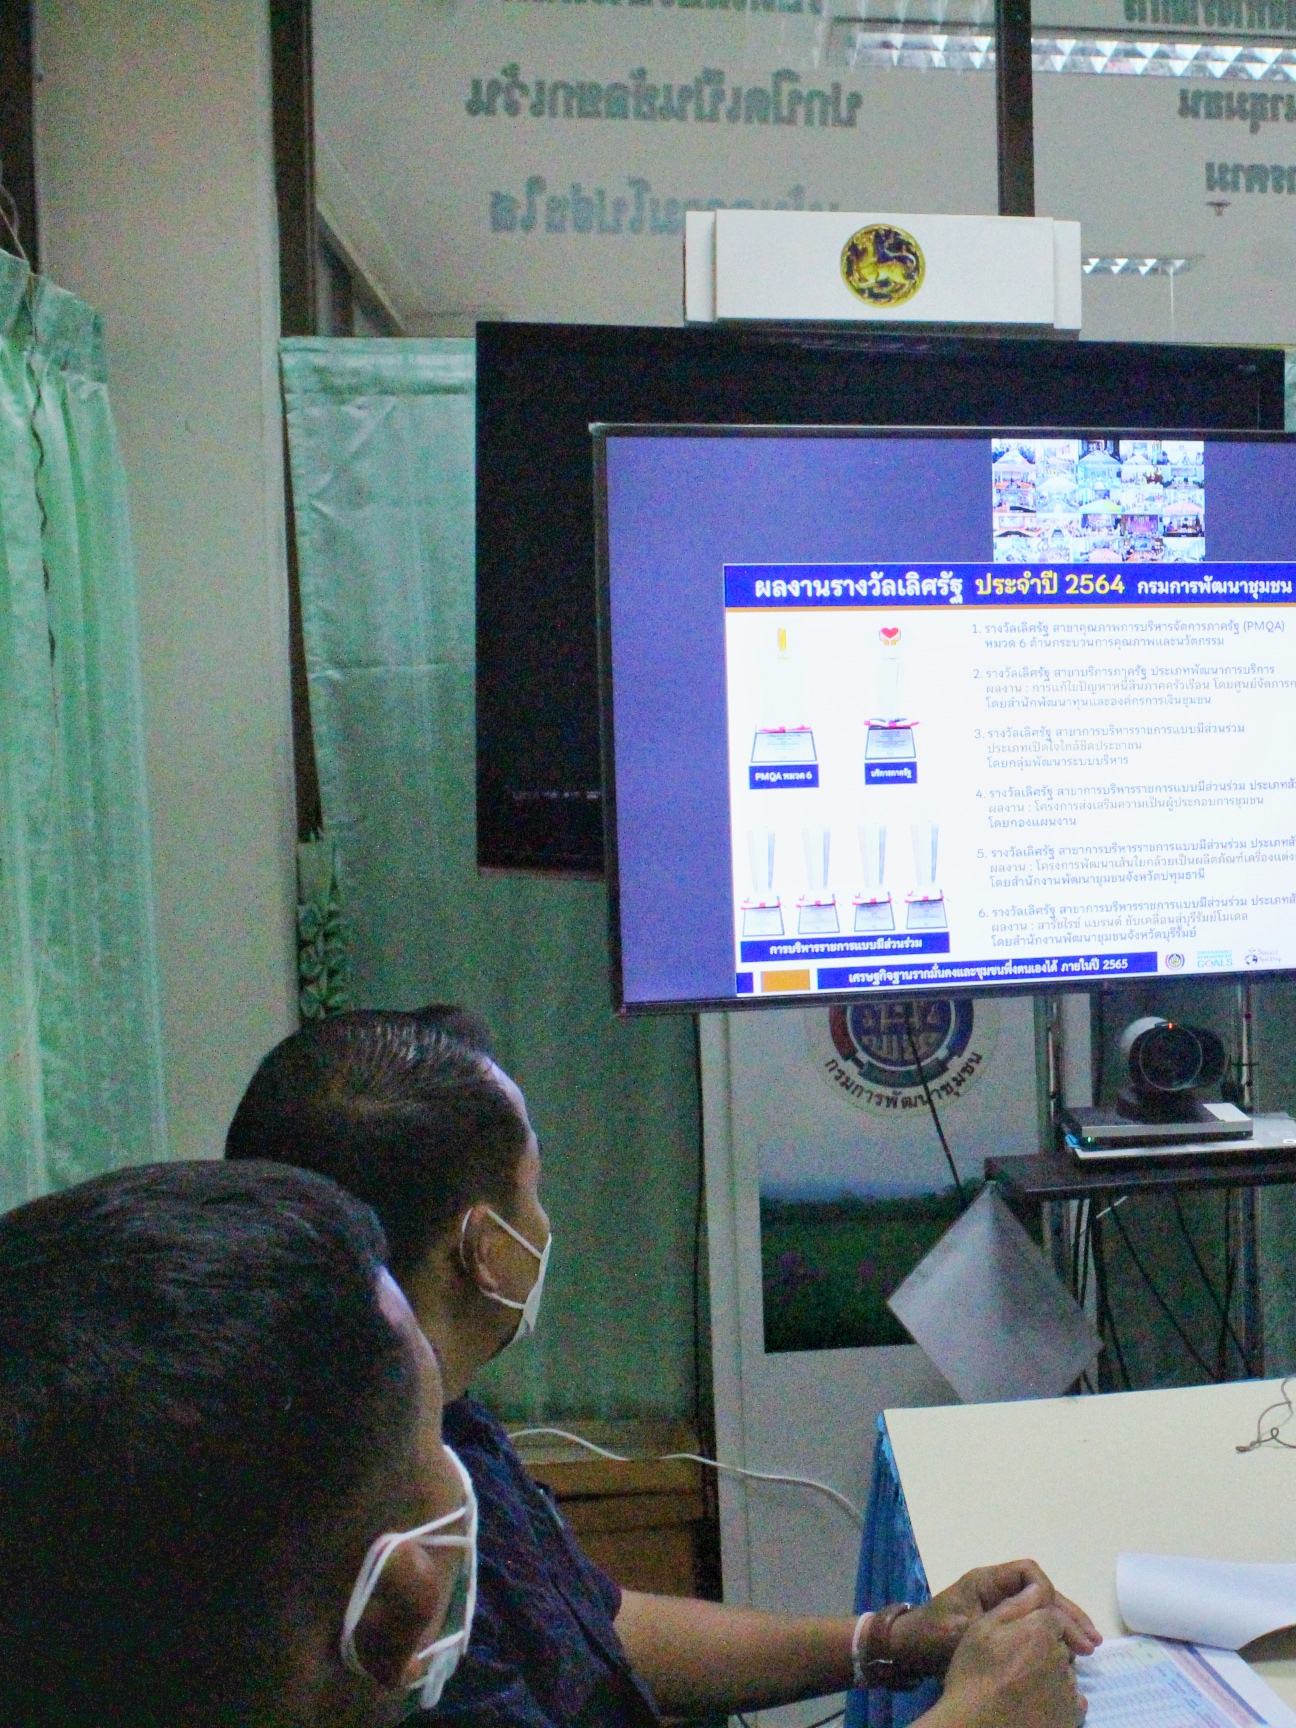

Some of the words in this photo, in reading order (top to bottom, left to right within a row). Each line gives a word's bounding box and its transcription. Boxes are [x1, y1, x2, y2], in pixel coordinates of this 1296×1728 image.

[755, 571, 964, 604] ผลงานรางวัลเลิศรัฐ
[975, 570, 1059, 596] ประจำปี
[1065, 573, 1125, 595] 2564
[1138, 574, 1292, 600] กรมการพัฒนาชุมชน
[972, 624, 982, 634] 1.
[985, 620, 1049, 637] รางวัลเลิศรัฐ
[1053, 620, 1240, 637] สาขาคุณภาพการบริหารจัดการภาครัฐ
[1243, 620, 1285, 632] (PMQA)
[985, 637, 1016, 648] หมวด
[1019, 638, 1026, 648] 6
[1030, 636, 1224, 650] ด้านกระบวนการคุณภาพและนวัตกรรม
[973, 669, 983, 679] 2.
[986, 666, 1050, 681] รางวัลเลิศรัฐ
[1151, 664, 1275, 677] ประเภทพัฒนาการบริการ
[986, 684, 1024, 694] ผลงาน
[974, 729, 985, 739] 3.
[988, 726, 1052, 741] รางวัลเลิศรัฐ
[1055, 722, 1245, 738] สาขาการบริหารราชการแบบมีส่วนร่วม
[755, 772, 782, 782] PMQA
[806, 772, 813, 780] 6
[976, 788, 986, 799] 4.
[989, 785, 1053, 800] รางวัลเลิศรัฐ
[1057, 780, 1246, 797] สาขาการบริหารราชการแบบมีส่วนร่วม
[988, 815, 1077, 829] โดยกองแผนงาน
[977, 849, 987, 859] 5.
[991, 845, 1055, 860] รางวัลเลิศรัฐ
[1058, 838, 1247, 856] สาขาการบริหารราชการแบบมีส่วนร่วม
[978, 908, 988, 918] 6.
[992, 904, 1056, 919] รางวัลเลิศรัฐ
[1059, 897, 1247, 915] สาขาการบริหารราชการแบบมีส่วนร่วม
[1103, 958, 1128, 971] 2565
[1197, 958, 1233, 968] GOALS
[825, 1053, 983, 1109] กรมการพัฒนาชุมชน
